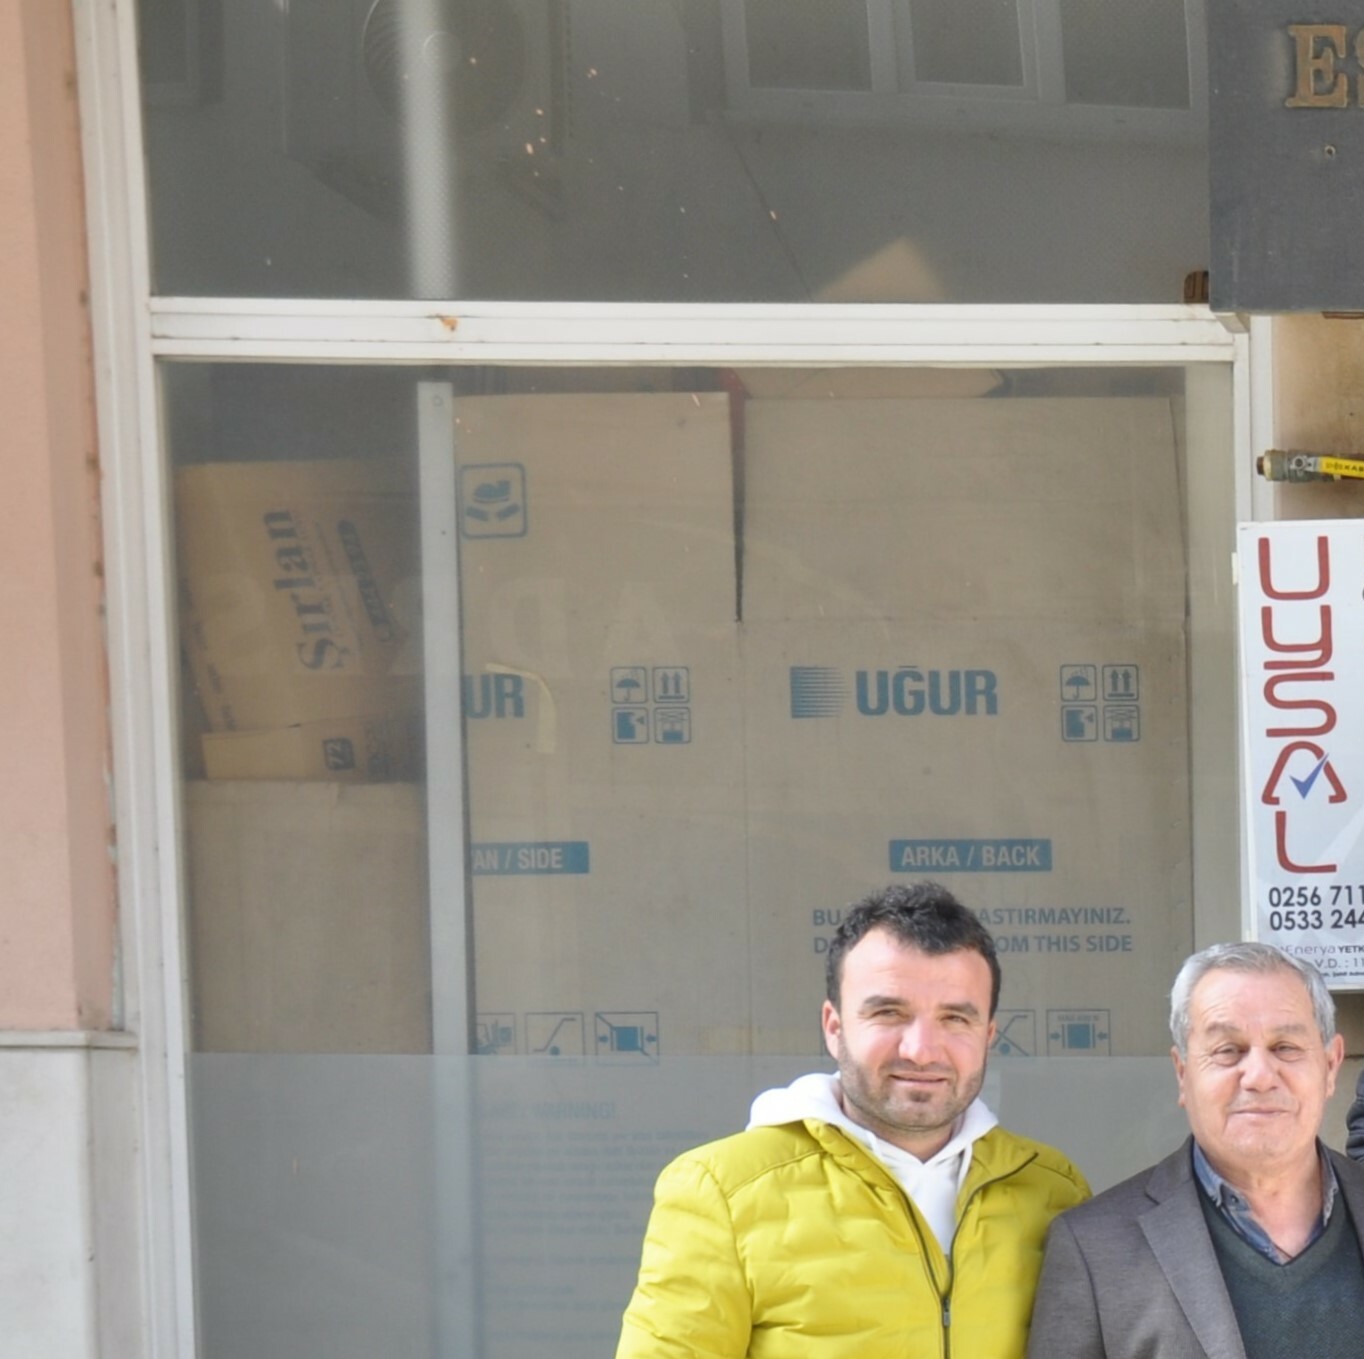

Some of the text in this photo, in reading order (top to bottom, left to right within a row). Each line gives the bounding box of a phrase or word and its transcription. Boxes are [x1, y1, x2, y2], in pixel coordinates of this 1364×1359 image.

[463, 673, 525, 719] UR
[518, 848, 563, 869] SIDE
[901, 844, 960, 868] ARKA
[981, 844, 1041, 868] BACK
[1268, 886, 1322, 908] 0256
[977, 908, 1132, 925] ASTIRMAYINIZ.
[1270, 910, 1323, 931] 0533
[1033, 935, 1081, 953] THIS
[1086, 935, 1133, 953] SIDE
